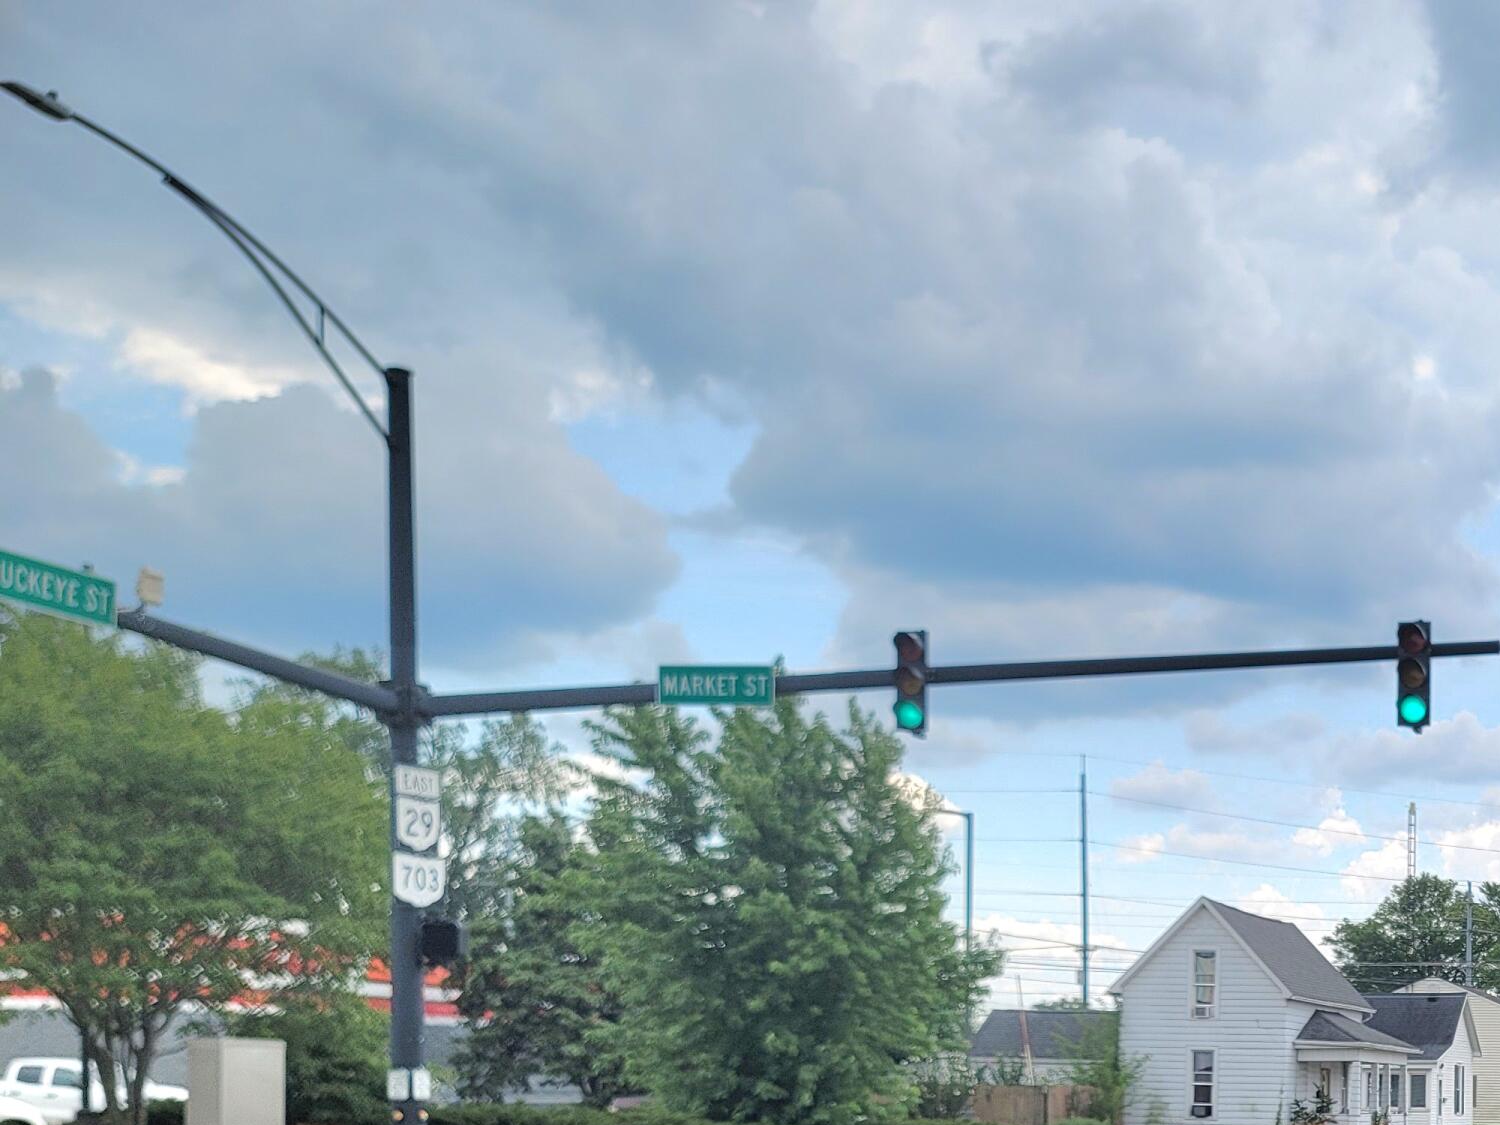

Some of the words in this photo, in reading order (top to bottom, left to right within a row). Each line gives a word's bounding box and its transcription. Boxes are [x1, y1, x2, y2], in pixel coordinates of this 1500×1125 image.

[84, 583, 112, 617] ST
[664, 672, 738, 697] MARKET
[743, 673, 769, 697] ST
[405, 808, 434, 838] 29
[402, 865, 440, 893] 703
